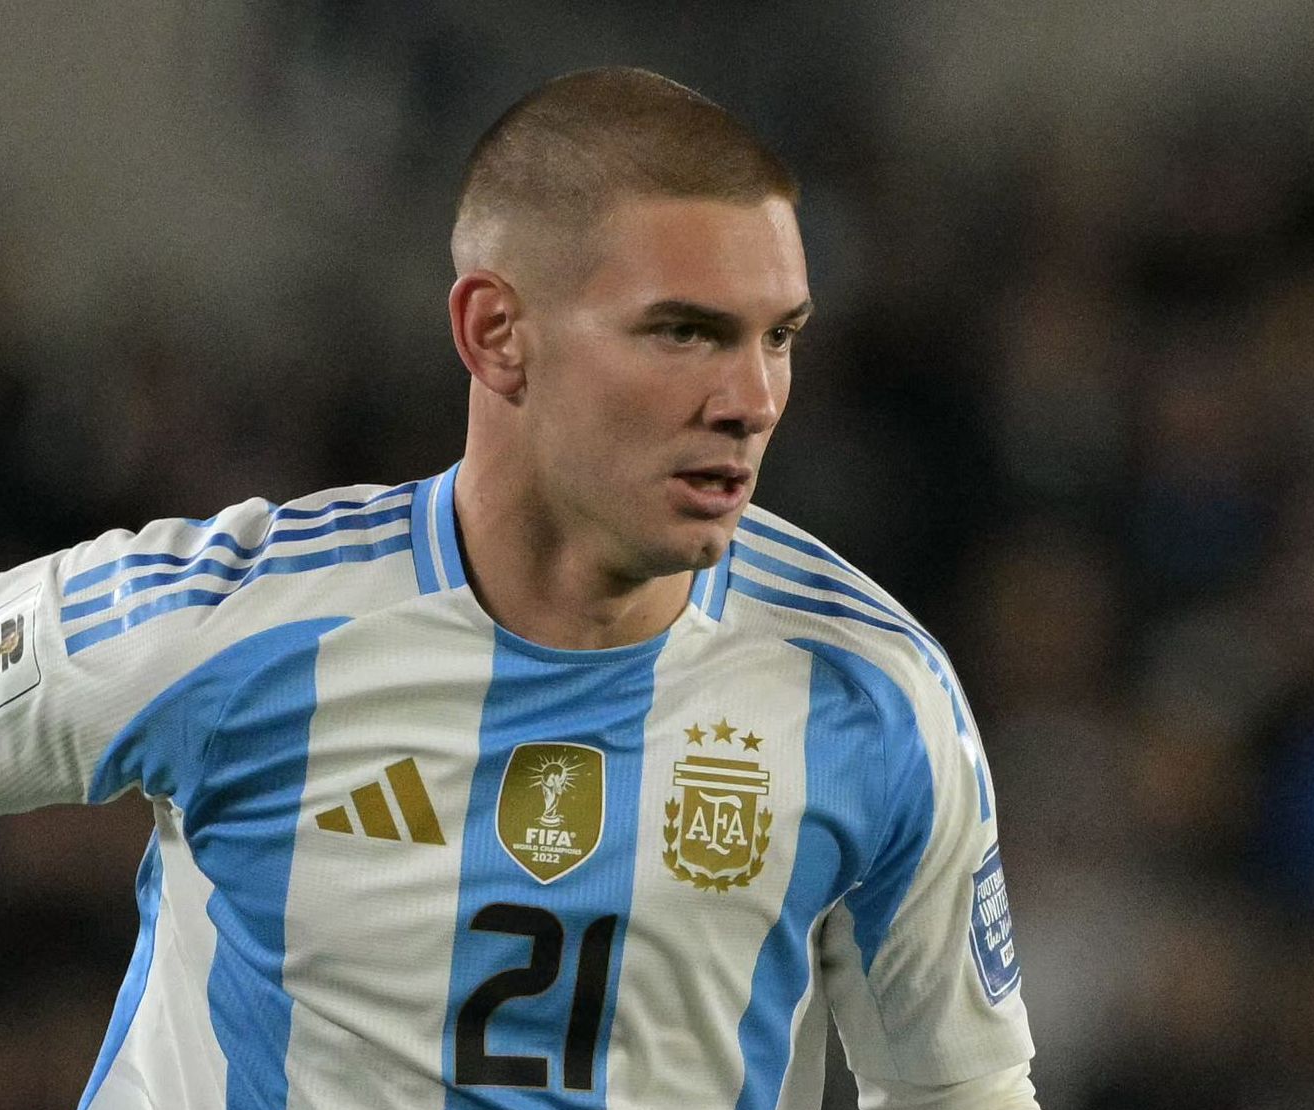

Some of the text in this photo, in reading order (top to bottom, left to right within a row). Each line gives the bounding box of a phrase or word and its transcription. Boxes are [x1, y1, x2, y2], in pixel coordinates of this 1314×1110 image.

[685, 790, 748, 855] AFA
[525, 828, 572, 847] FIFA
[513, 843, 582, 855] WORLD CHAMPIONS
[532, 852, 560, 864] 2022
[454, 902, 619, 1091] 21
